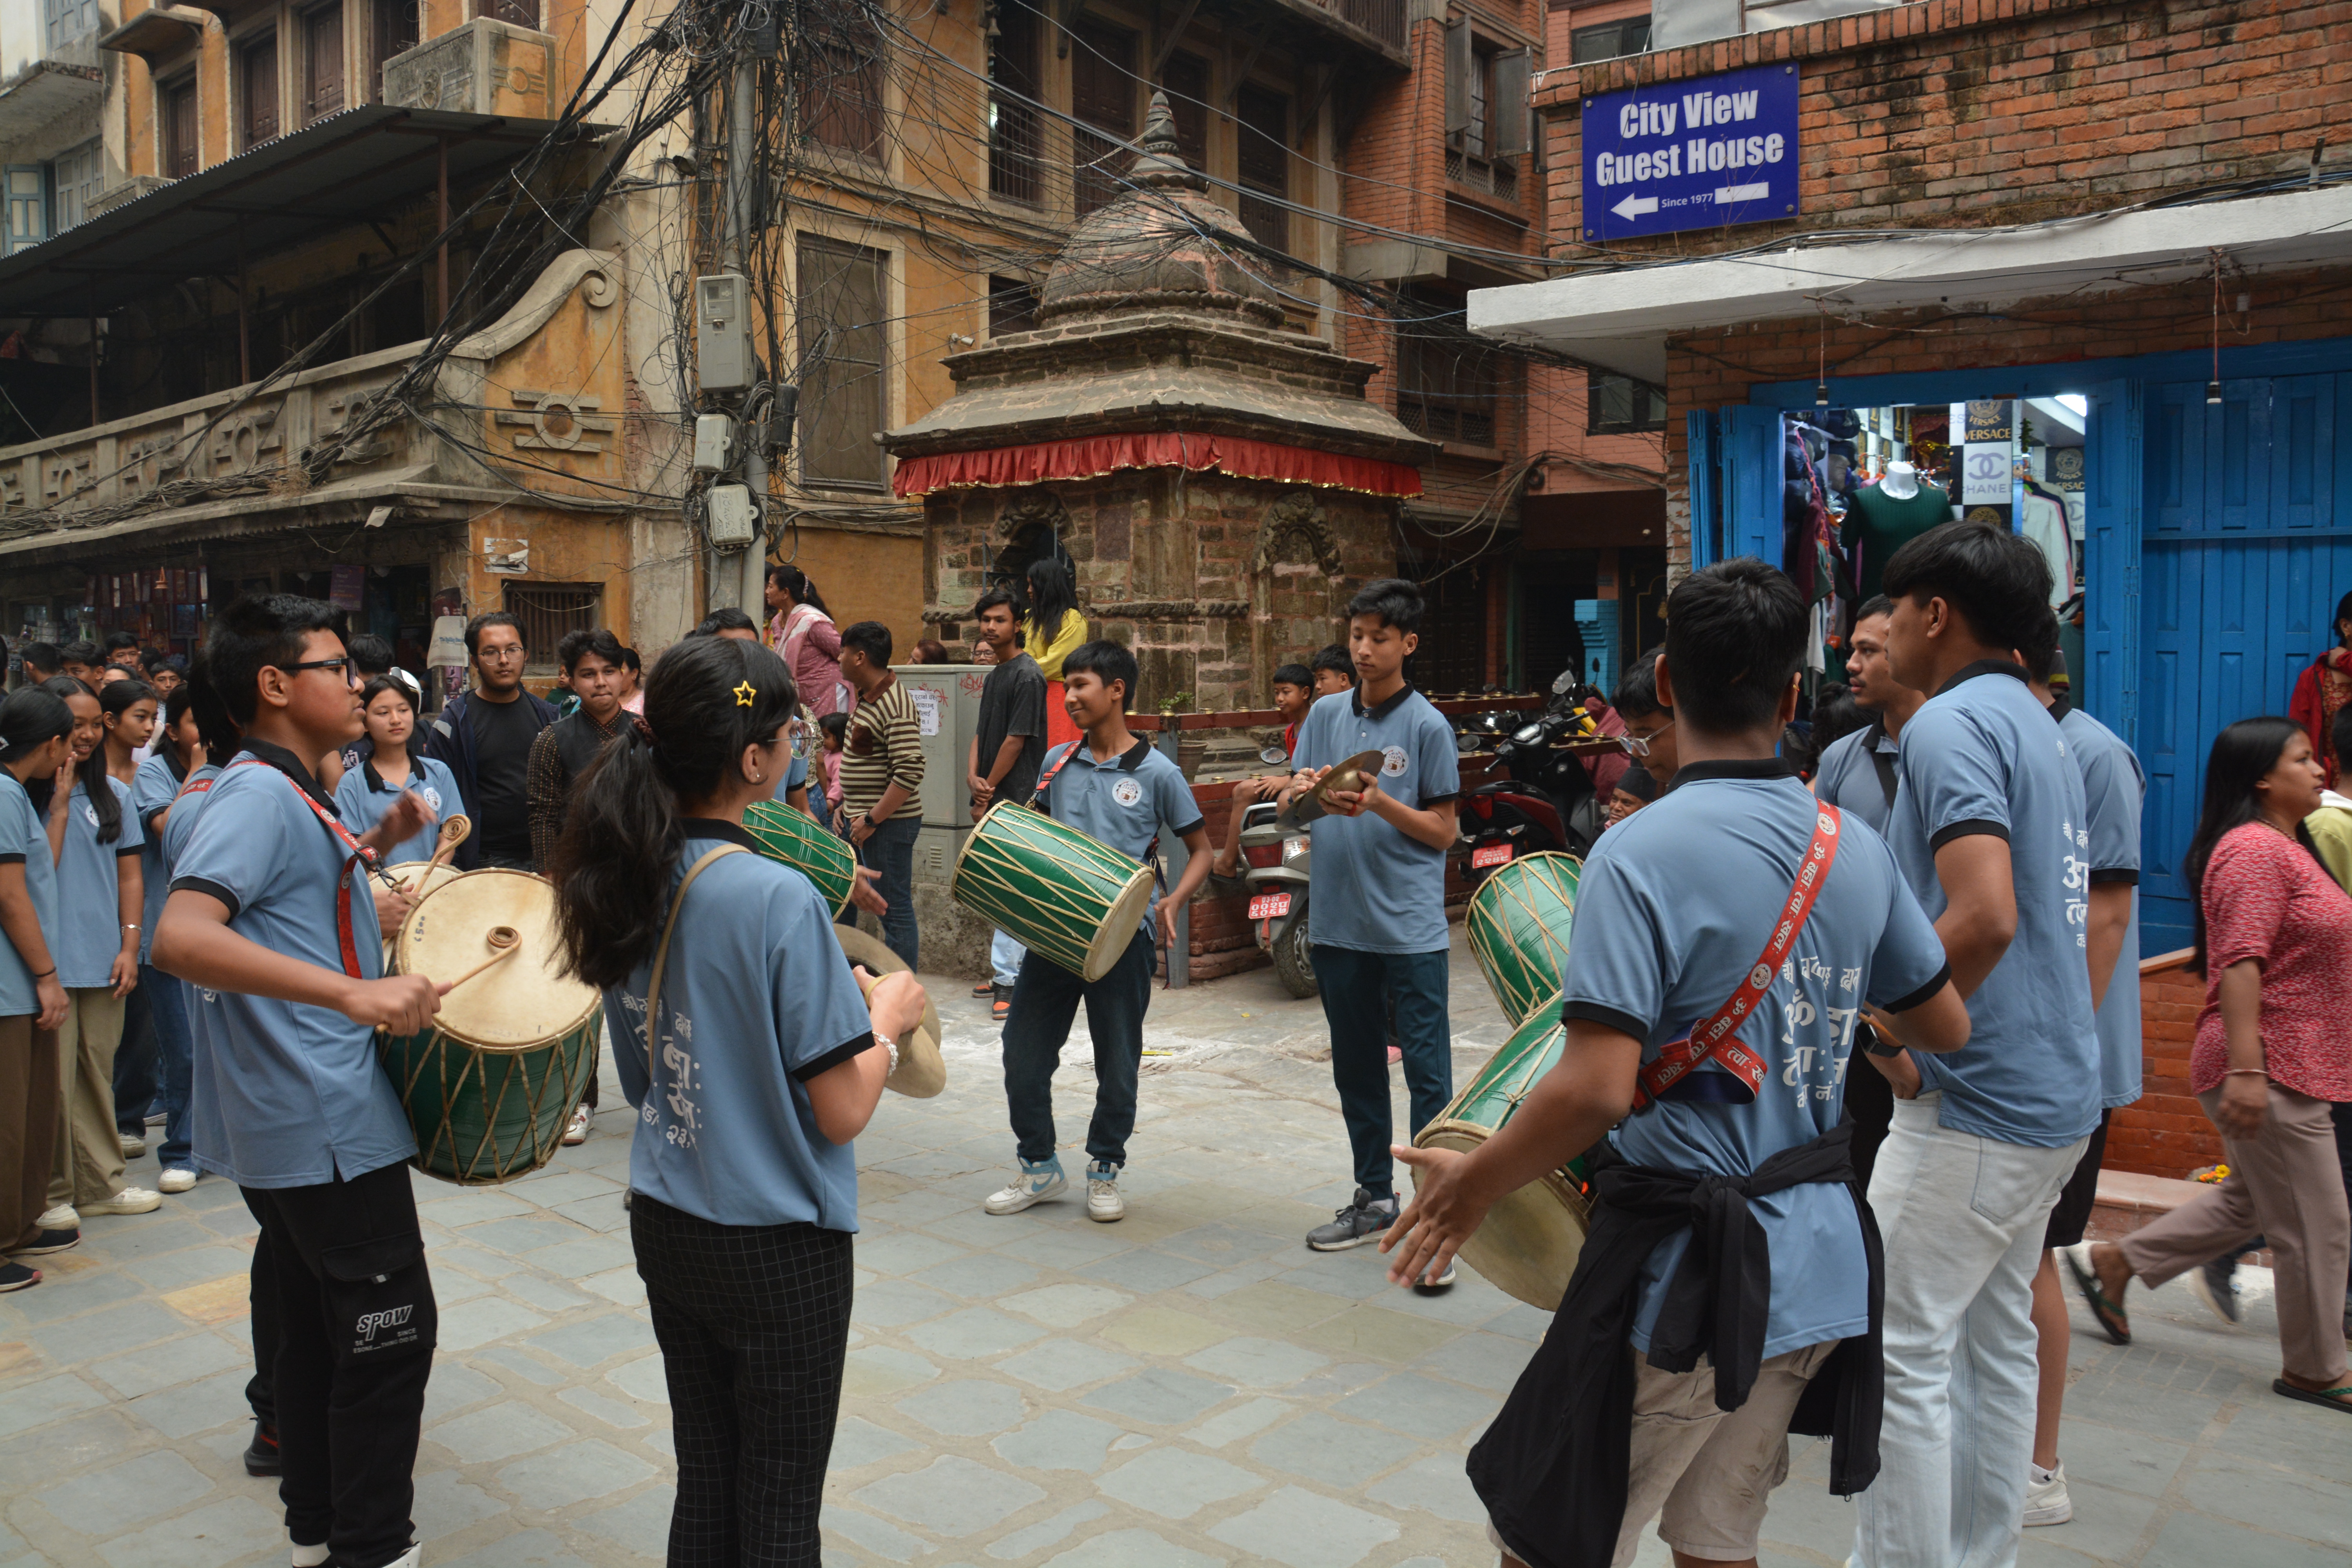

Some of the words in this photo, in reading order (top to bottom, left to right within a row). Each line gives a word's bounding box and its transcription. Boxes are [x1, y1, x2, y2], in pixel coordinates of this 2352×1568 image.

[1620, 102, 1677, 138] City
[1683, 90, 1759, 129] View
[1596, 144, 1681, 187] Guest
[1688, 132, 1784, 174] House
[1661, 196, 1688, 208] Since
[1690, 193, 1713, 205] 1977
[1969, 414, 2002, 426] VERSACE
[1964, 428, 2011, 440] VERSACE
[1814, 842, 1825, 860] ॐ
[1733, 997, 1747, 1015] ॐ
[356, 1305, 413, 1341] SPOW
[397, 1328, 417, 1337] SINCE
